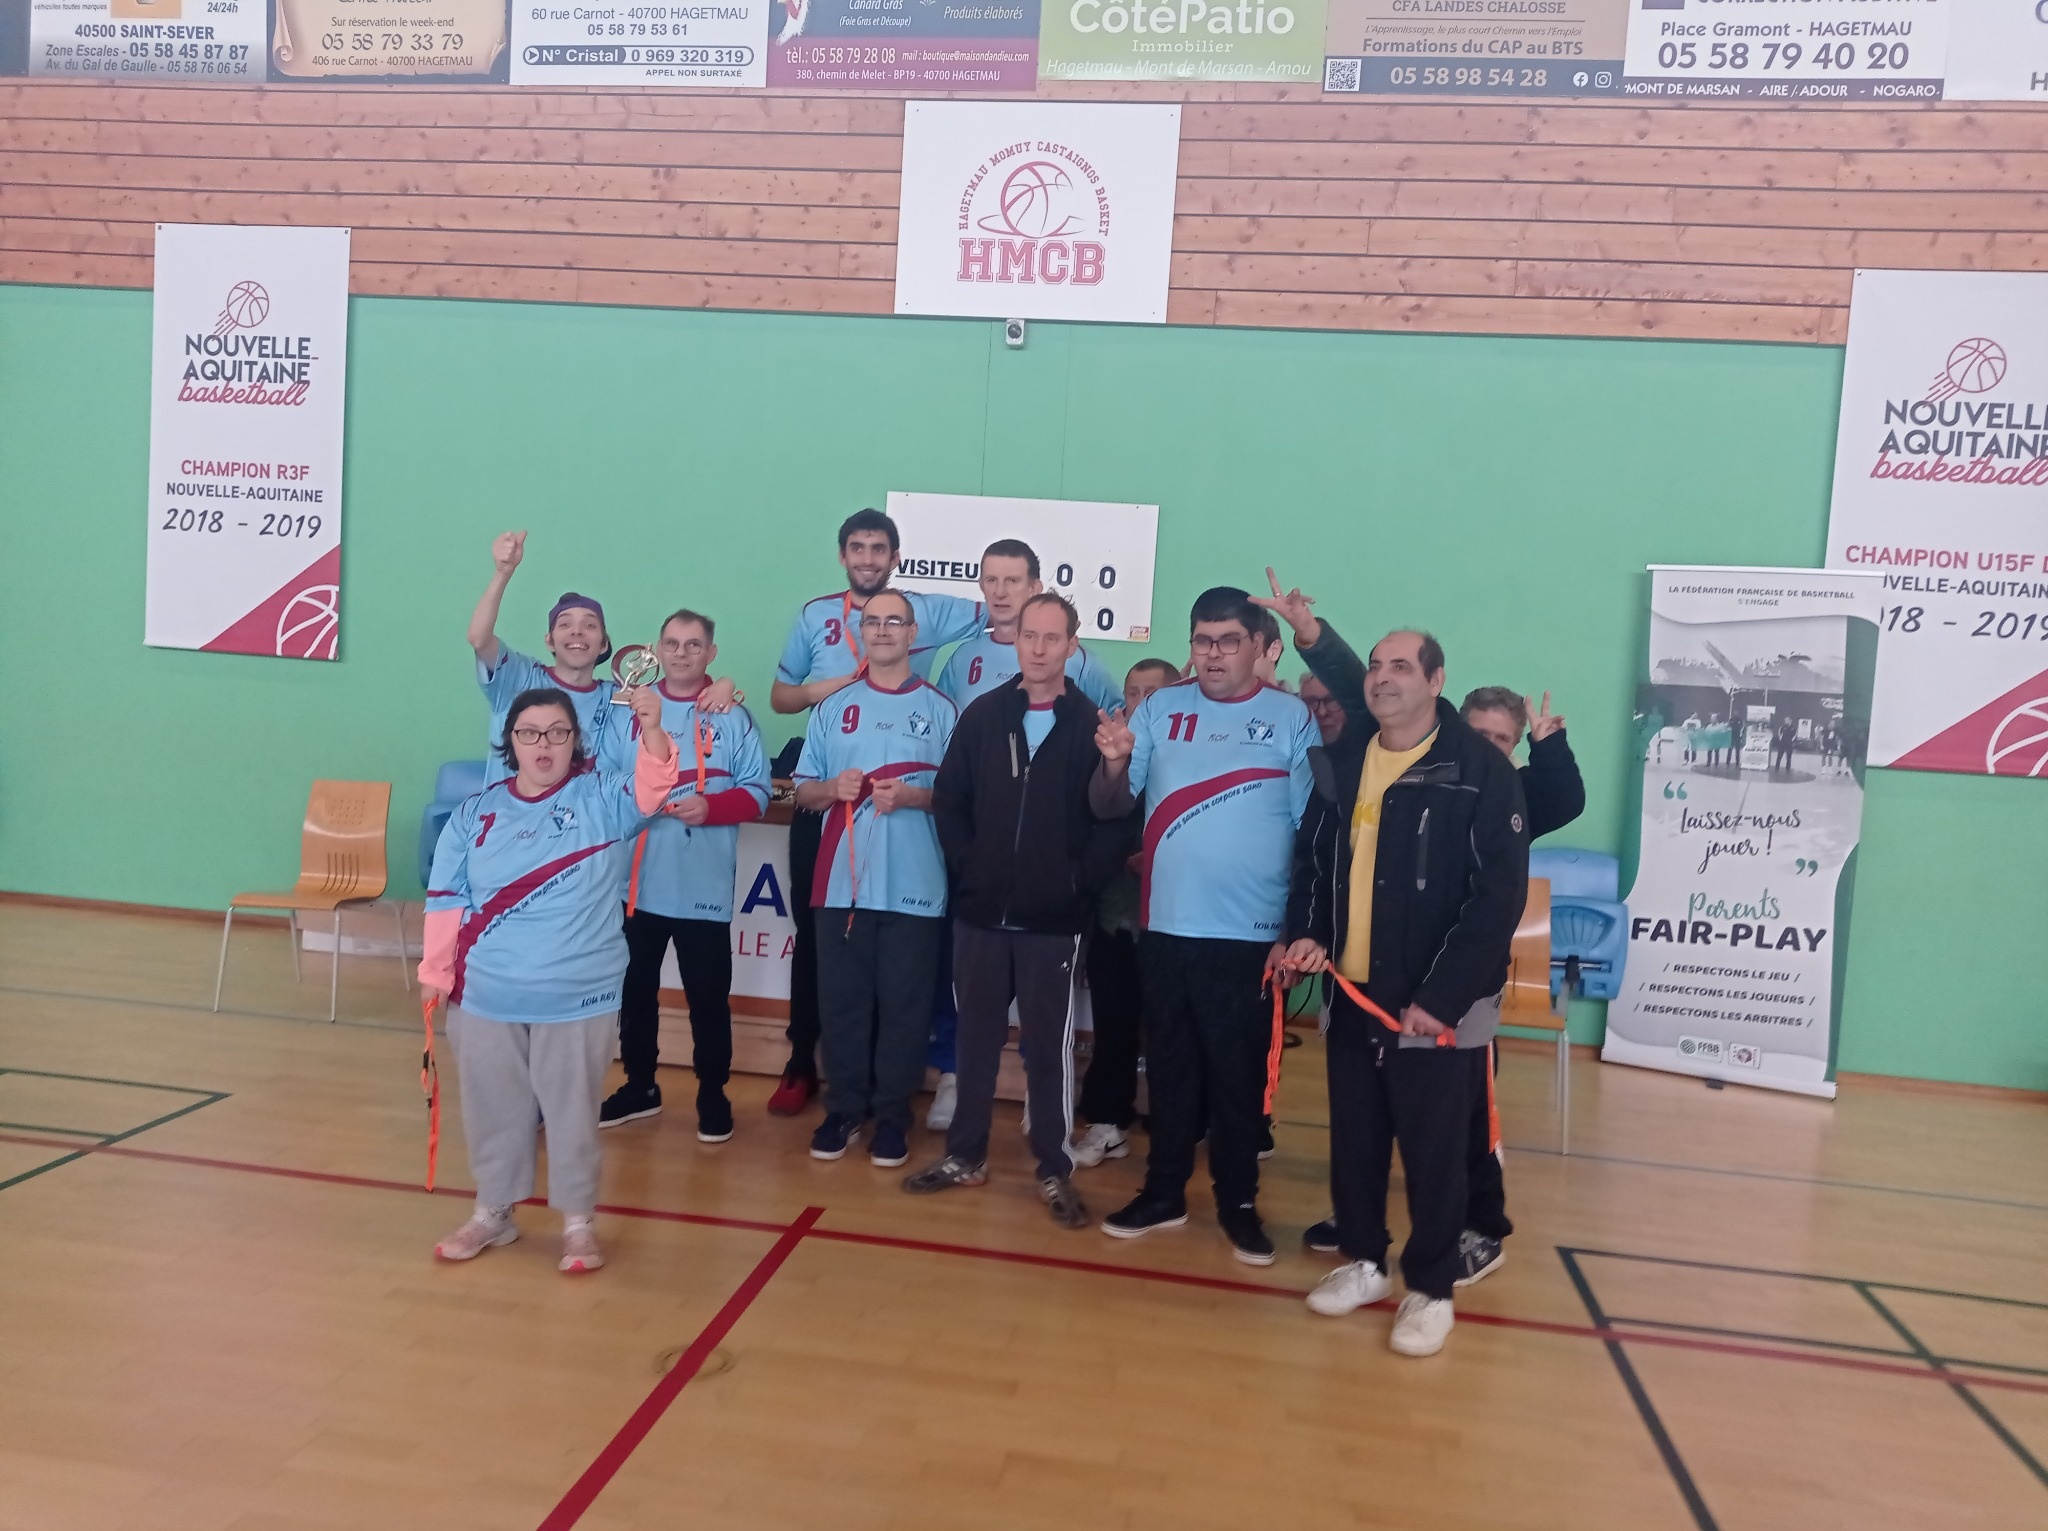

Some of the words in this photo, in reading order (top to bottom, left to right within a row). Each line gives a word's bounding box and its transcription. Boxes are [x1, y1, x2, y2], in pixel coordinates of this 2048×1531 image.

[207, 2, 238, 14] 24/24h
[531, 8, 547, 20] 60
[550, 10, 570, 20] rue
[573, 8, 615, 20] Carnot
[628, 8, 667, 20] 40700
[670, 7, 749, 20] HAGETMAU
[944, 6, 982, 19] Produits
[984, 6, 1024, 19] élaborés
[1392, 0, 1421, 13] CFA
[1424, 0, 1484, 13] LANDES
[1487, 1, 1566, 14] CHALOSSE
[331, 17, 346, 27] Sur
[348, 16, 397, 27] réservation
[399, 17, 408, 27] le
[410, 17, 455, 27] week-end
[587, 24, 604, 36] 05
[608, 24, 625, 36] 58
[630, 24, 646, 36] 79
[650, 24, 667, 36] 53
[672, 24, 688, 36] 61
[857, 16, 872, 26] Gras
[873, 17, 881, 26] et
[1661, 21, 1707, 36] Place
[1712, 22, 1790, 37] Gramont
[1809, 21, 1912, 36] HAGETMAU
[75, 24, 116, 38] 40500
[120, 25, 214, 40] SAINT-SEVER
[46, 44, 73, 56] Zone
[76, 44, 119, 57] Escales
[130, 42, 149, 58] 05
[154, 42, 174, 58] 58
[178, 43, 199, 59] 45
[204, 44, 223, 60] 87
[229, 44, 249, 60] 87
[321, 33, 344, 50] 05
[351, 33, 374, 50] 58
[381, 33, 403, 51] 79
[411, 33, 433, 51] 33
[442, 33, 464, 51] 79
[1132, 39, 1234, 53] Immobilier
[1363, 38, 1458, 54] Formations
[1461, 39, 1484, 54] du
[1488, 41, 1523, 55] CAP
[1526, 43, 1548, 55] au
[1551, 41, 1584, 56] BTS
[312, 56, 330, 66] 406
[332, 58, 346, 66] rue
[348, 56, 378, 66] Carnot
[386, 56, 416, 66] 40700
[418, 56, 473, 66] HAGETMAU
[542, 50, 561, 62] N°
[565, 49, 619, 62] Cristal
[631, 50, 640, 62] 0
[645, 50, 675, 62] 969
[680, 50, 709, 62] 320
[715, 50, 744, 63] 319
[812, 48, 826, 64] 05
[829, 48, 843, 64] 58
[847, 48, 861, 64] 79
[864, 48, 878, 64] 28
[882, 48, 896, 64] 08
[902, 50, 918, 61] mail
[922, 50, 1030, 64] boutique@maisondandieu.com
[1658, 42, 1697, 69] 05
[1708, 42, 1749, 69] 58
[1761, 42, 1802, 70] 79
[1812, 42, 1855, 70] 40
[1867, 42, 1909, 70] 20
[645, 69, 675, 77] APPEL
[678, 69, 698, 77] NON
[700, 69, 742, 77] SURTAXÉ
[796, 69, 814, 81] 380,
[816, 69, 847, 80] chemin
[849, 69, 860, 80] de
[861, 69, 885, 80] Melet
[893, 70, 915, 80] BP19
[923, 70, 950, 80] 40700
[952, 70, 1000, 81] HAGETMAU
[1047, 59, 1123, 77] Hagetmau
[1134, 60, 1174, 75] Mont
[1177, 60, 1194, 75] de
[1198, 60, 1254, 75] Marsan
[1265, 61, 1312, 76] Amou
[1390, 67, 1417, 85] 05
[1422, 67, 1449, 85] 58
[1455, 68, 1482, 86] 98
[1487, 68, 1515, 86] 54
[1520, 69, 1547, 87] 28
[1667, 83, 1684, 95] DE
[1686, 84, 1741, 96] MARSAN
[1759, 84, 1789, 96] AIRE
[1799, 85, 1848, 97] ADOUR
[1873, 85, 1936, 97] NOGARO
[959, 164, 989, 230] HAGETMAU
[989, 141, 1031, 167] MOMUY
[1037, 141, 1100, 185] CASTAIGNOS
[1094, 186, 1110, 236] BASKET
[957, 237, 1106, 286] HMCB
[183, 359, 310, 384] AQUITAINE
[178, 377, 310, 406] basketball
[181, 460, 271, 479] CHAMPION
[277, 464, 310, 481] R3F
[166, 482, 323, 503] NOUVELLE-AQUITAINE
[162, 508, 224, 533] 2018
[259, 513, 322, 539] 2019
[1845, 545, 1969, 570] CHAMPION
[1977, 552, 2036, 572] U15F
[898, 559, 979, 579] VISITEU
[1056, 563, 1073, 587] 0
[1099, 566, 1116, 589] 0
[1668, 585, 1679, 594] LA
[1681, 585, 1735, 595] FÉDÉRATION
[1736, 588, 1784, 597] FRANÇAISE
[1787, 589, 1798, 597] DE
[1800, 590, 1855, 599] BASKETBALL
[1097, 608, 1114, 631] 0
[824, 618, 842, 646] 3
[968, 656, 983, 685] 6
[841, 704, 861, 734] 9
[1168, 712, 1199, 742] 11
[1680, 807, 1802, 833] Laissez-nous
[475, 812, 497, 848] 7
[1687, 887, 1781, 924] Parents
[1631, 917, 1827, 953] FAIR-PLAY
[1673, 963, 1749, 979] RESPECTONS
[1751, 970, 1766, 980] LE
[1767, 971, 1790, 982] JEU
[1648, 983, 1725, 998] RESPECTONS
[1726, 989, 1748, 1000] LES
[1749, 991, 1805, 1005] JOUEURS
[1643, 1003, 1719, 1020] RESPECTONS
[1720, 1010, 1742, 1022] LES
[1743, 1013, 1803, 1028] ARBITRES
